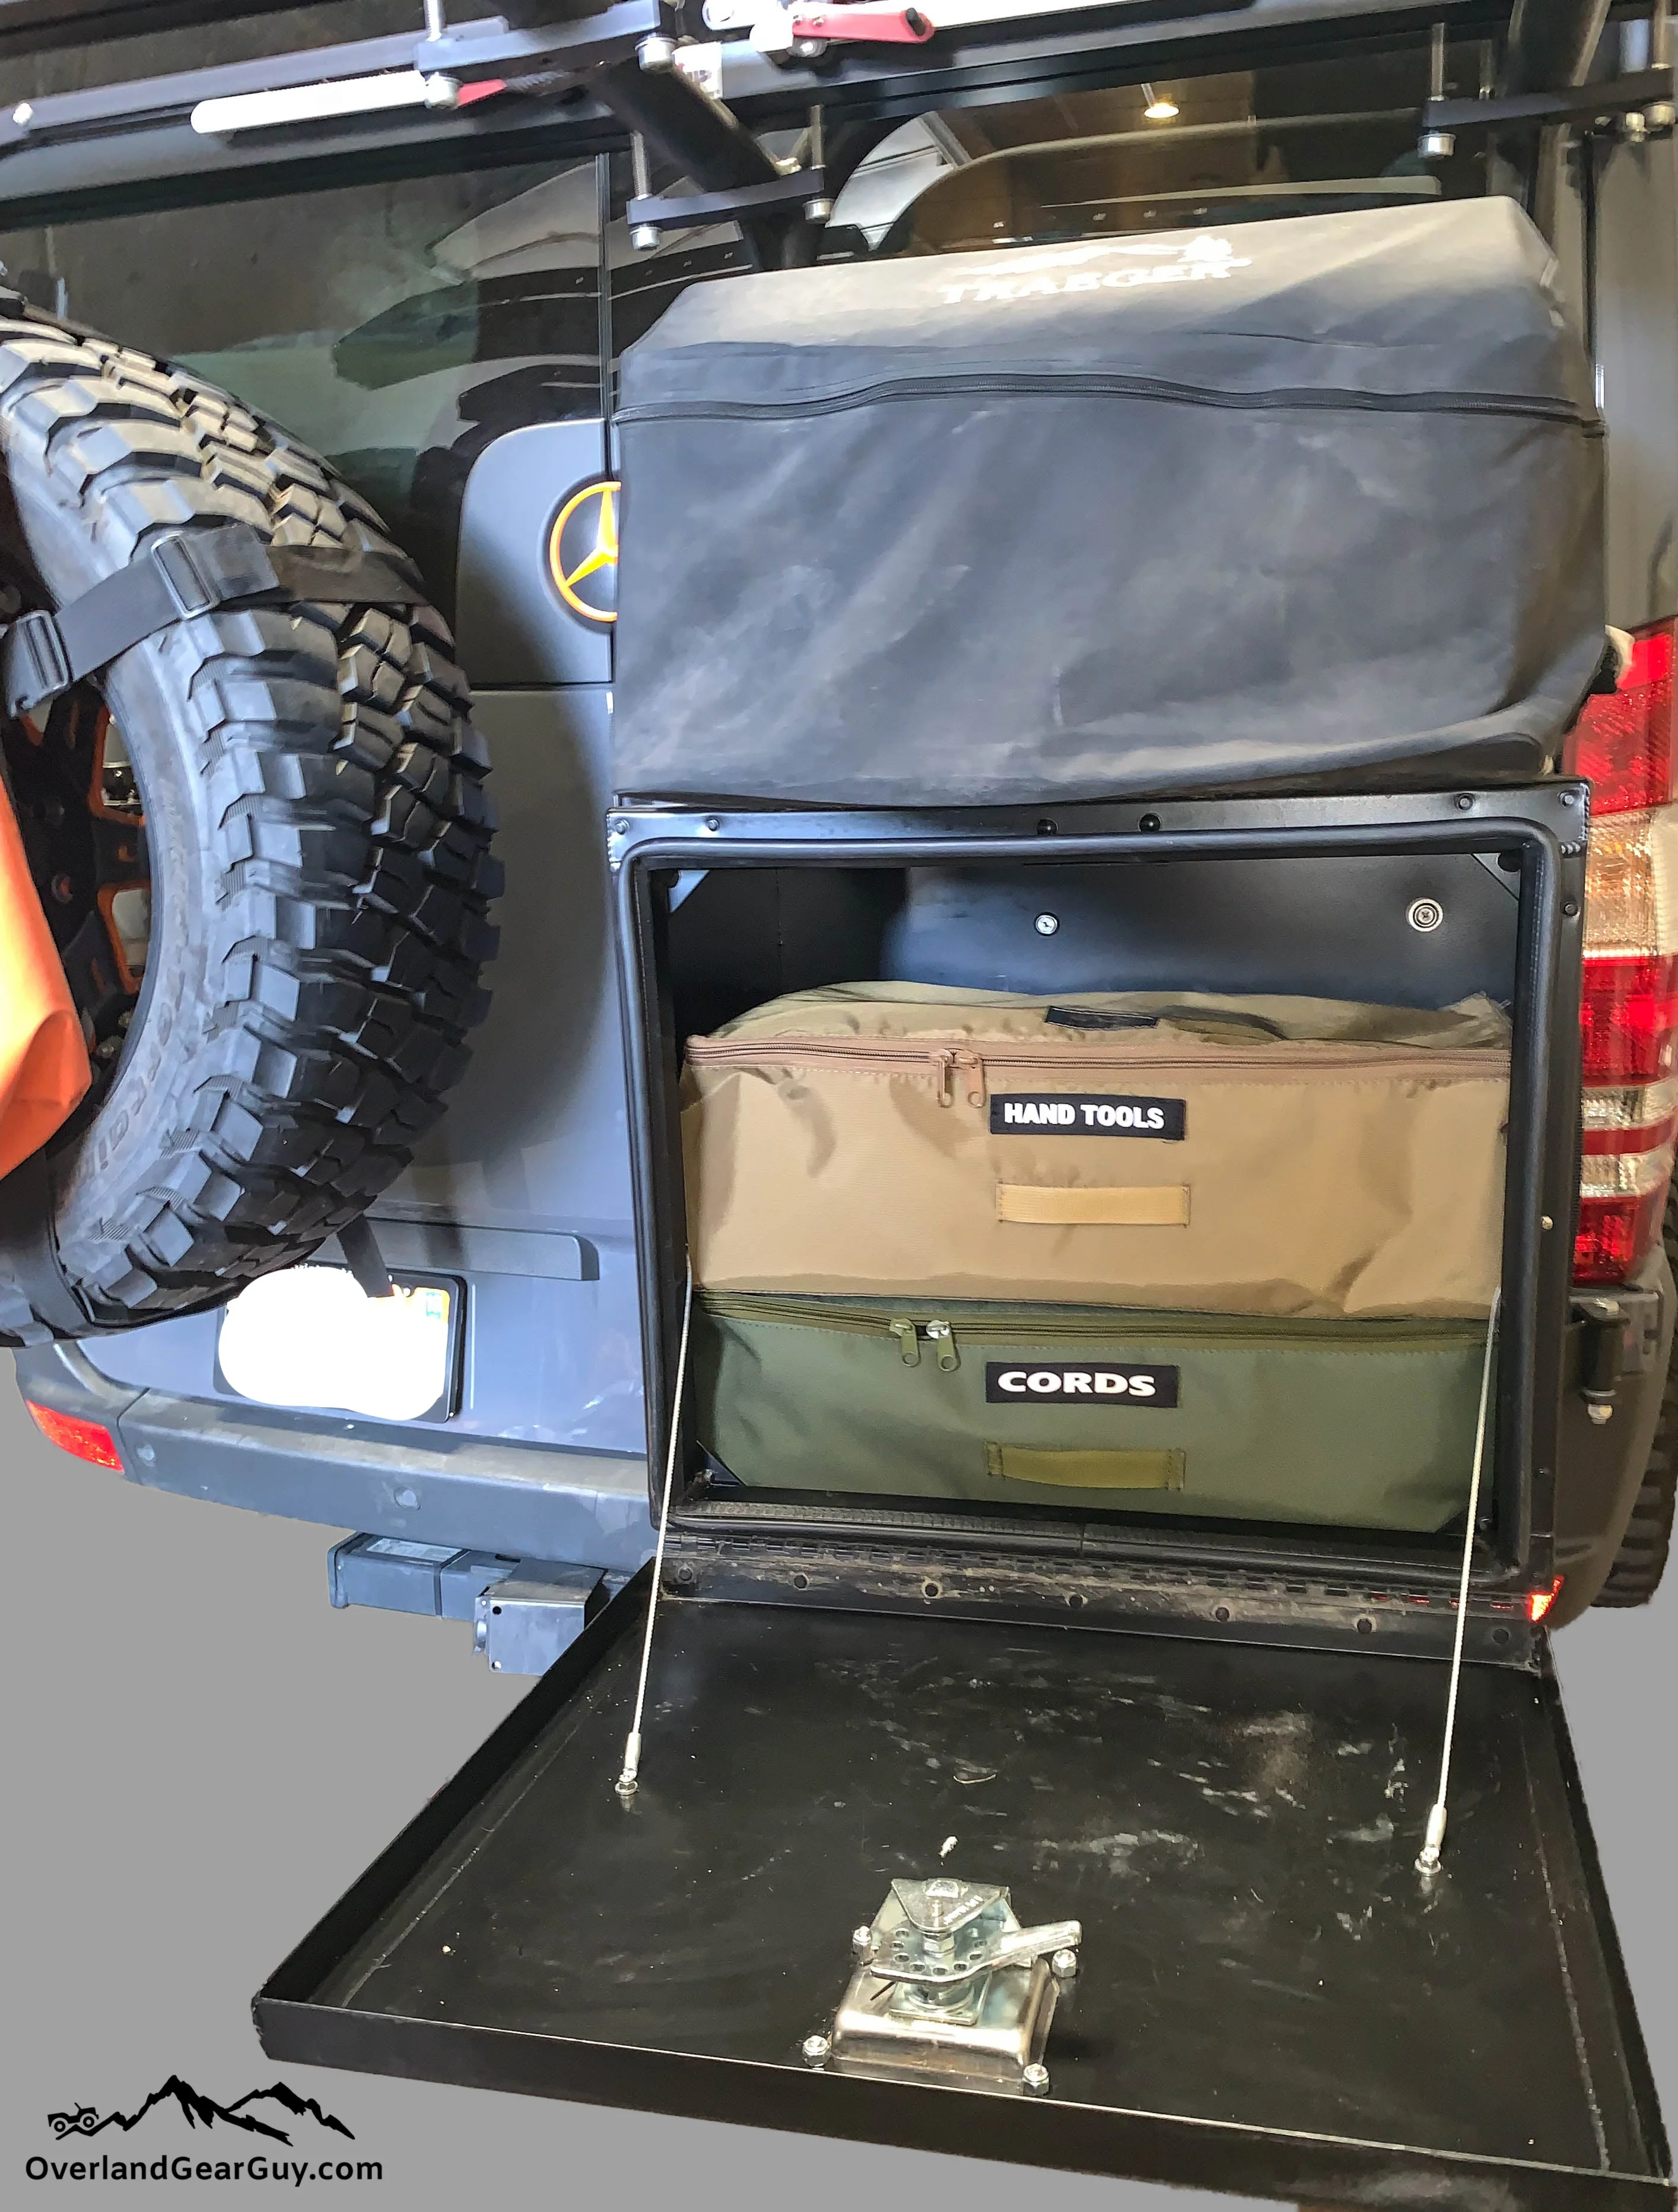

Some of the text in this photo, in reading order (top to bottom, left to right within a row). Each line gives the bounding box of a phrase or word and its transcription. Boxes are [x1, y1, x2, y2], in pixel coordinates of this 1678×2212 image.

[1004, 1103, 1165, 1129] HAND TOOLS
[997, 1371, 1156, 1397] CORDS
